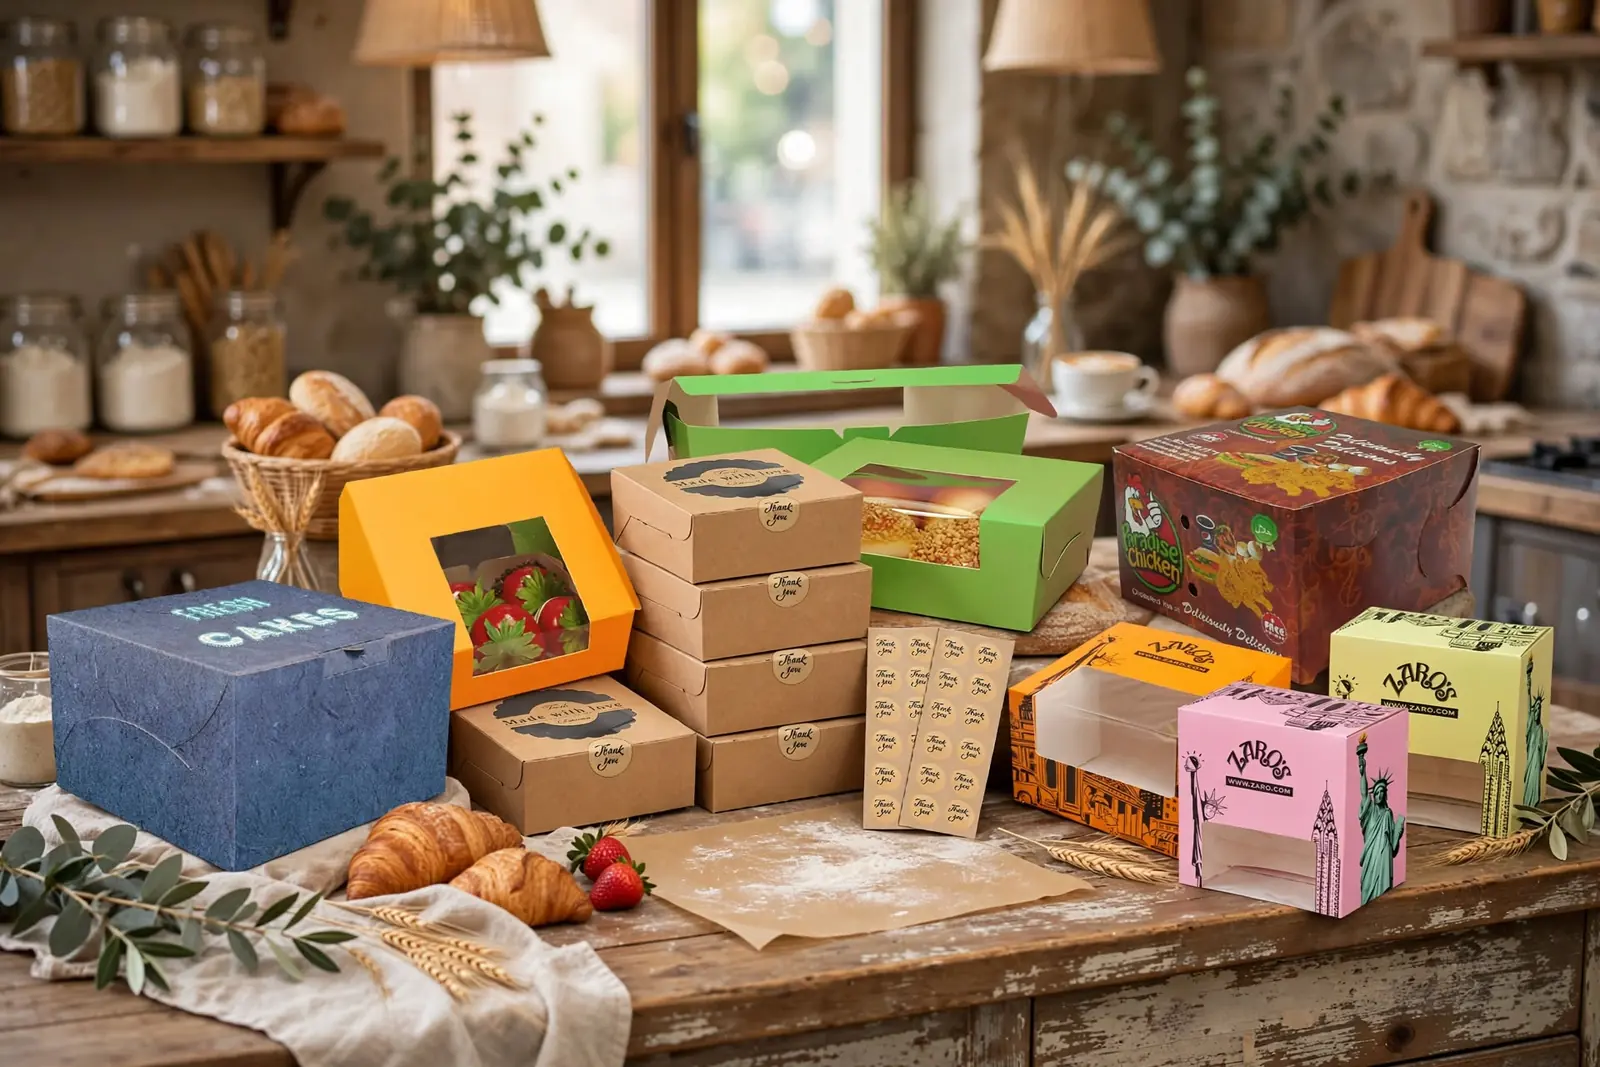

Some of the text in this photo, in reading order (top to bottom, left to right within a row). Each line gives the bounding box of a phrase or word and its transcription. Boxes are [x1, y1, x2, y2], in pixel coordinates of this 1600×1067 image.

[672, 478, 716, 488] Made
[720, 472, 755, 481] with
[764, 501, 793, 514] Thank
[1121, 521, 1179, 565] Paradise
[1127, 546, 1180, 585] Chicken
[774, 576, 802, 588] Thank
[198, 607, 359, 648] CAKES
[1182, 601, 1284, 657] Deliciously Deliciou
[876, 638, 896, 649] Thank
[910, 638, 931, 650] Thank
[944, 639, 964, 655] Thank
[779, 653, 807, 666] Thank
[978, 646, 998, 660] Thank
[1148, 641, 1215, 664] ZARO'S
[875, 669, 896, 680] Thank
[910, 669, 930, 679] Thank
[939, 671, 958, 684] Thank
[972, 677, 991, 691] Thank
[1383, 662, 1457, 702] ZARO'S
[875, 700, 895, 711] Thank
[931, 702, 952, 715] Thank
[1383, 701, 1456, 716] WWWZARO.COM
[502, 715, 545, 726] Made
[550, 708, 586, 718] with
[588, 702, 623, 712] love
[965, 707, 985, 721] Thank
[784, 727, 813, 741] Thank
[876, 733, 897, 745] Thank
[926, 735, 947, 747] Thank
[594, 743, 624, 758] Thank
[961, 741, 981, 755] Thank
[1226, 740, 1292, 780] ZARO'S
[875, 766, 896, 777] Thank
[920, 766, 940, 780] Thank
[954, 772, 974, 786] Thank
[1228, 777, 1292, 796] WWW.ZARO.COM
[874, 798, 895, 810] Thank
[914, 797, 935, 811] Thank
[948, 804, 969, 818] Thank
